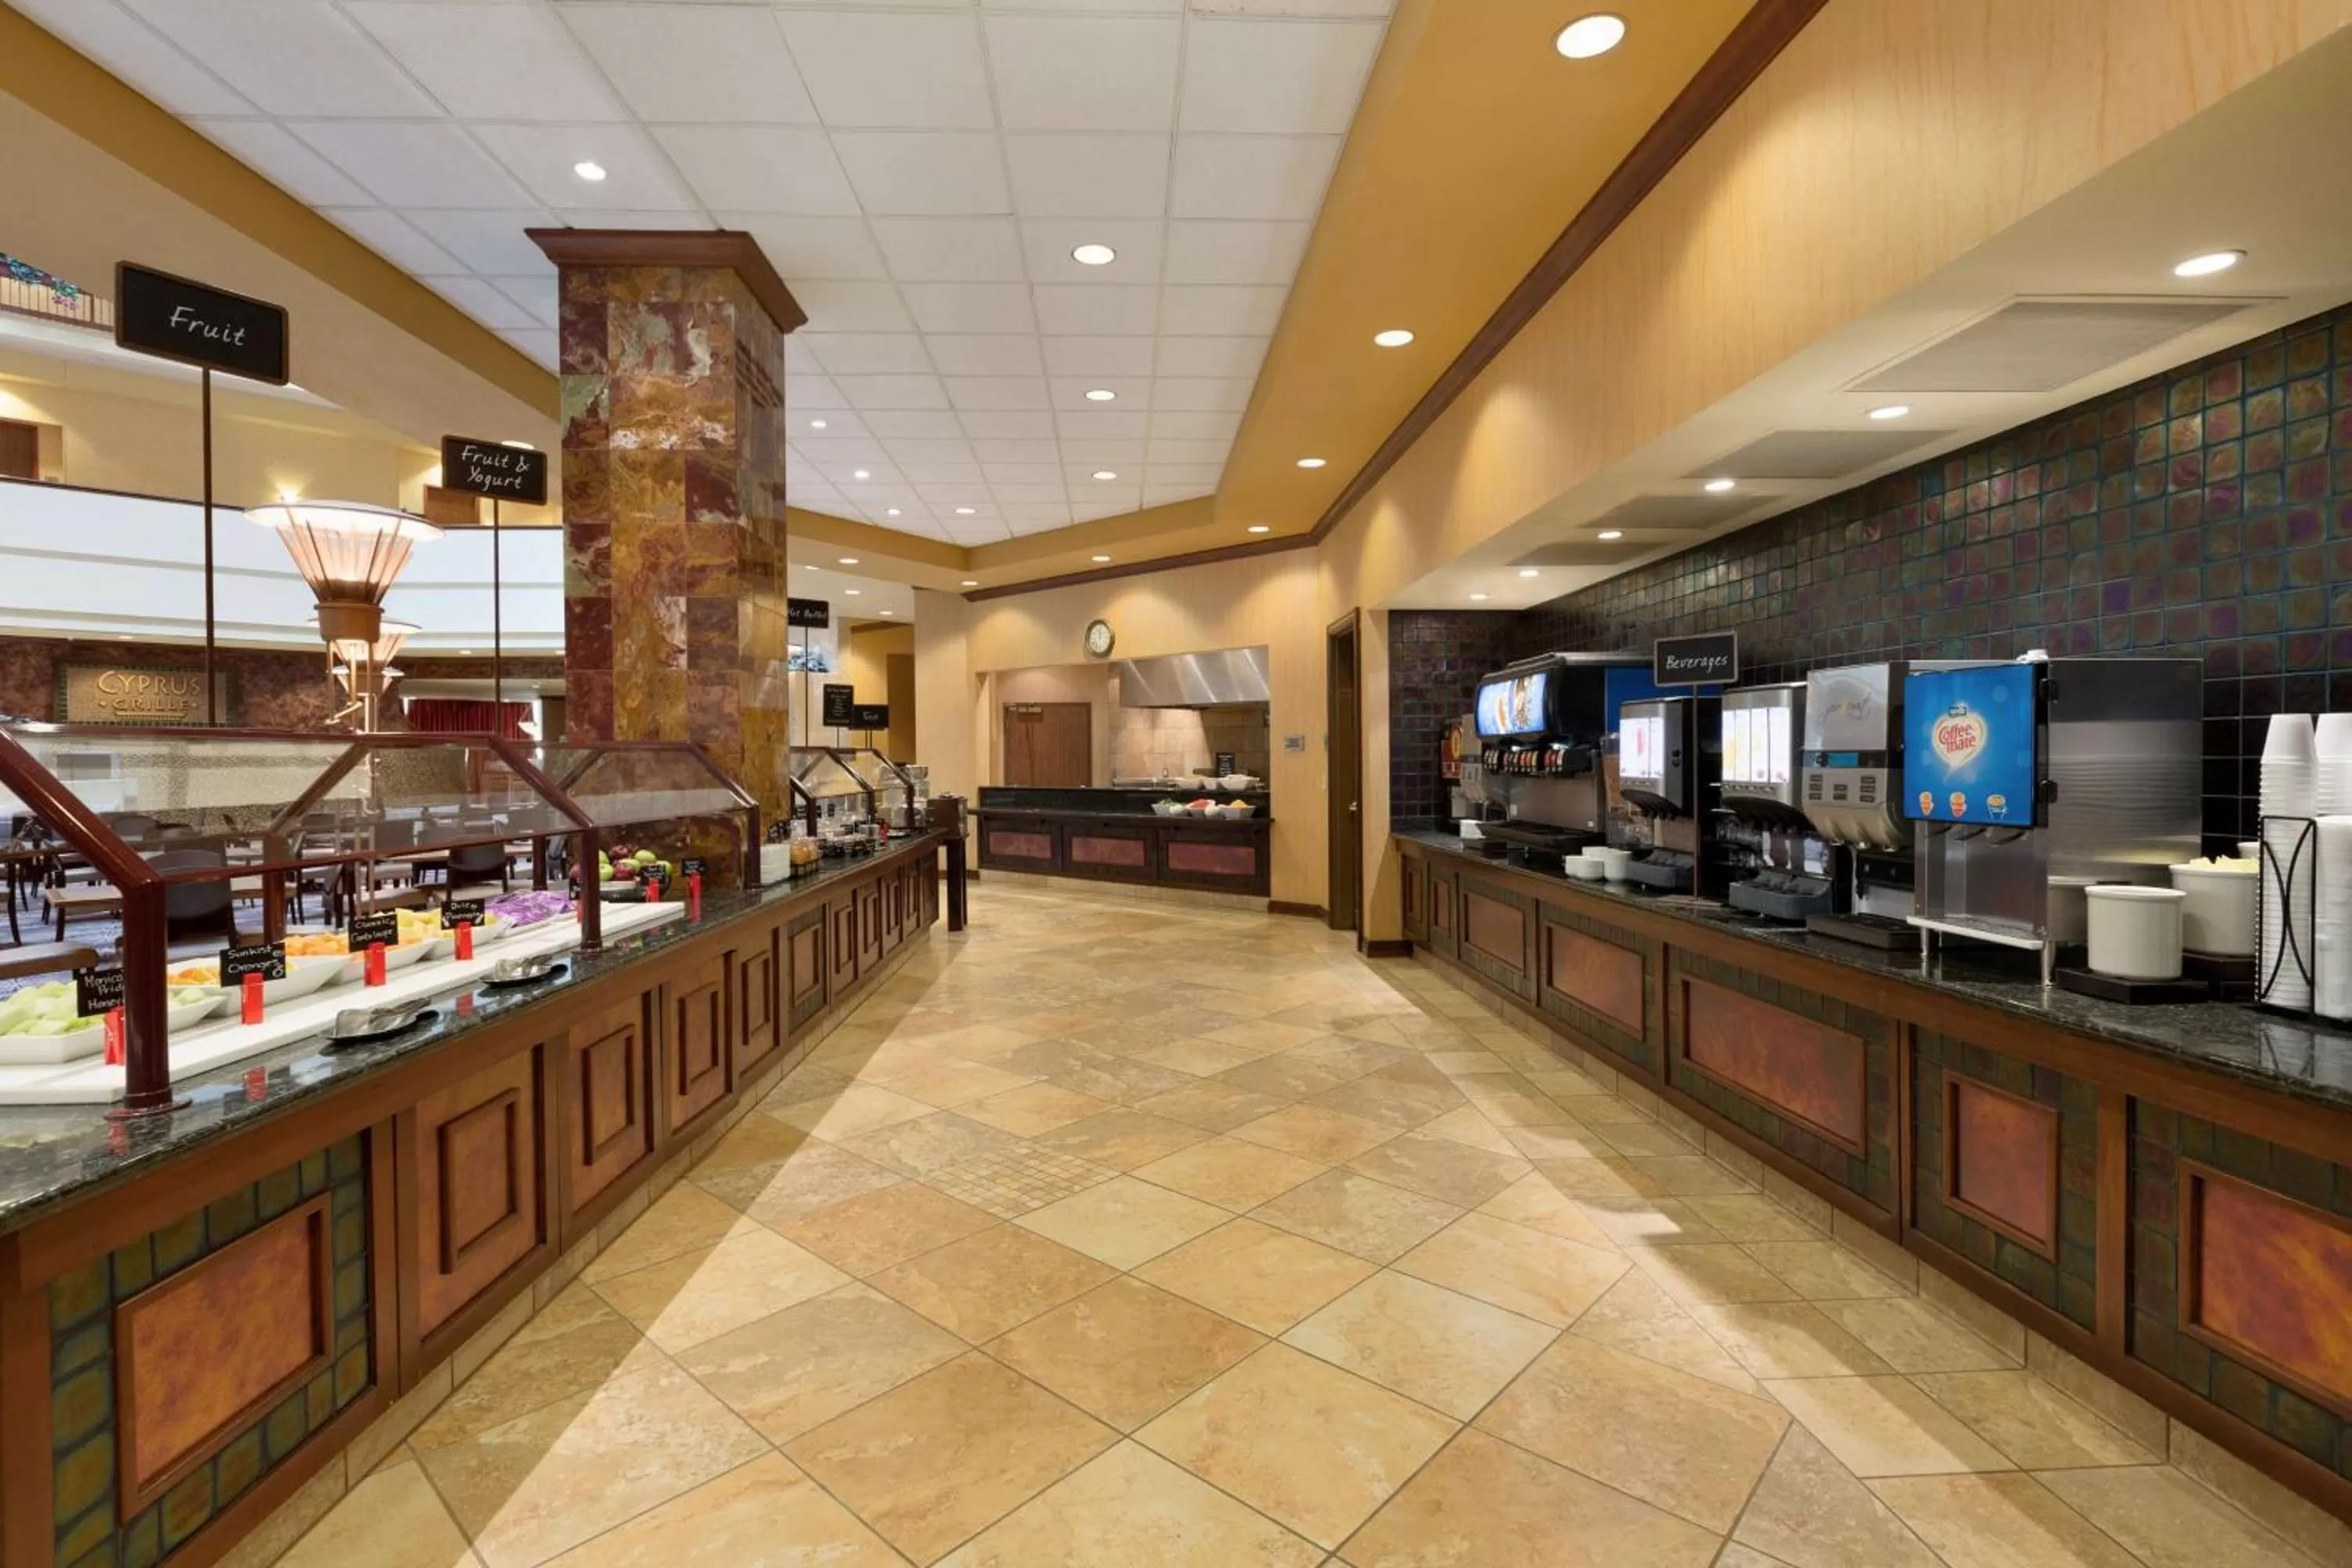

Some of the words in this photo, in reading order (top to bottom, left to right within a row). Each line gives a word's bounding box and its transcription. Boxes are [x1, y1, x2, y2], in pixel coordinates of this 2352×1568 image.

[169, 304, 247, 347] Fruit
[460, 445, 510, 468] Fruit
[514, 455, 530, 473] &
[466, 464, 523, 492] Yogurt
[1665, 654, 1729, 675] Beverages
[96, 670, 201, 696] CYPRUS
[112, 698, 190, 711] GRILLE
[227, 944, 272, 960] Sunkist
